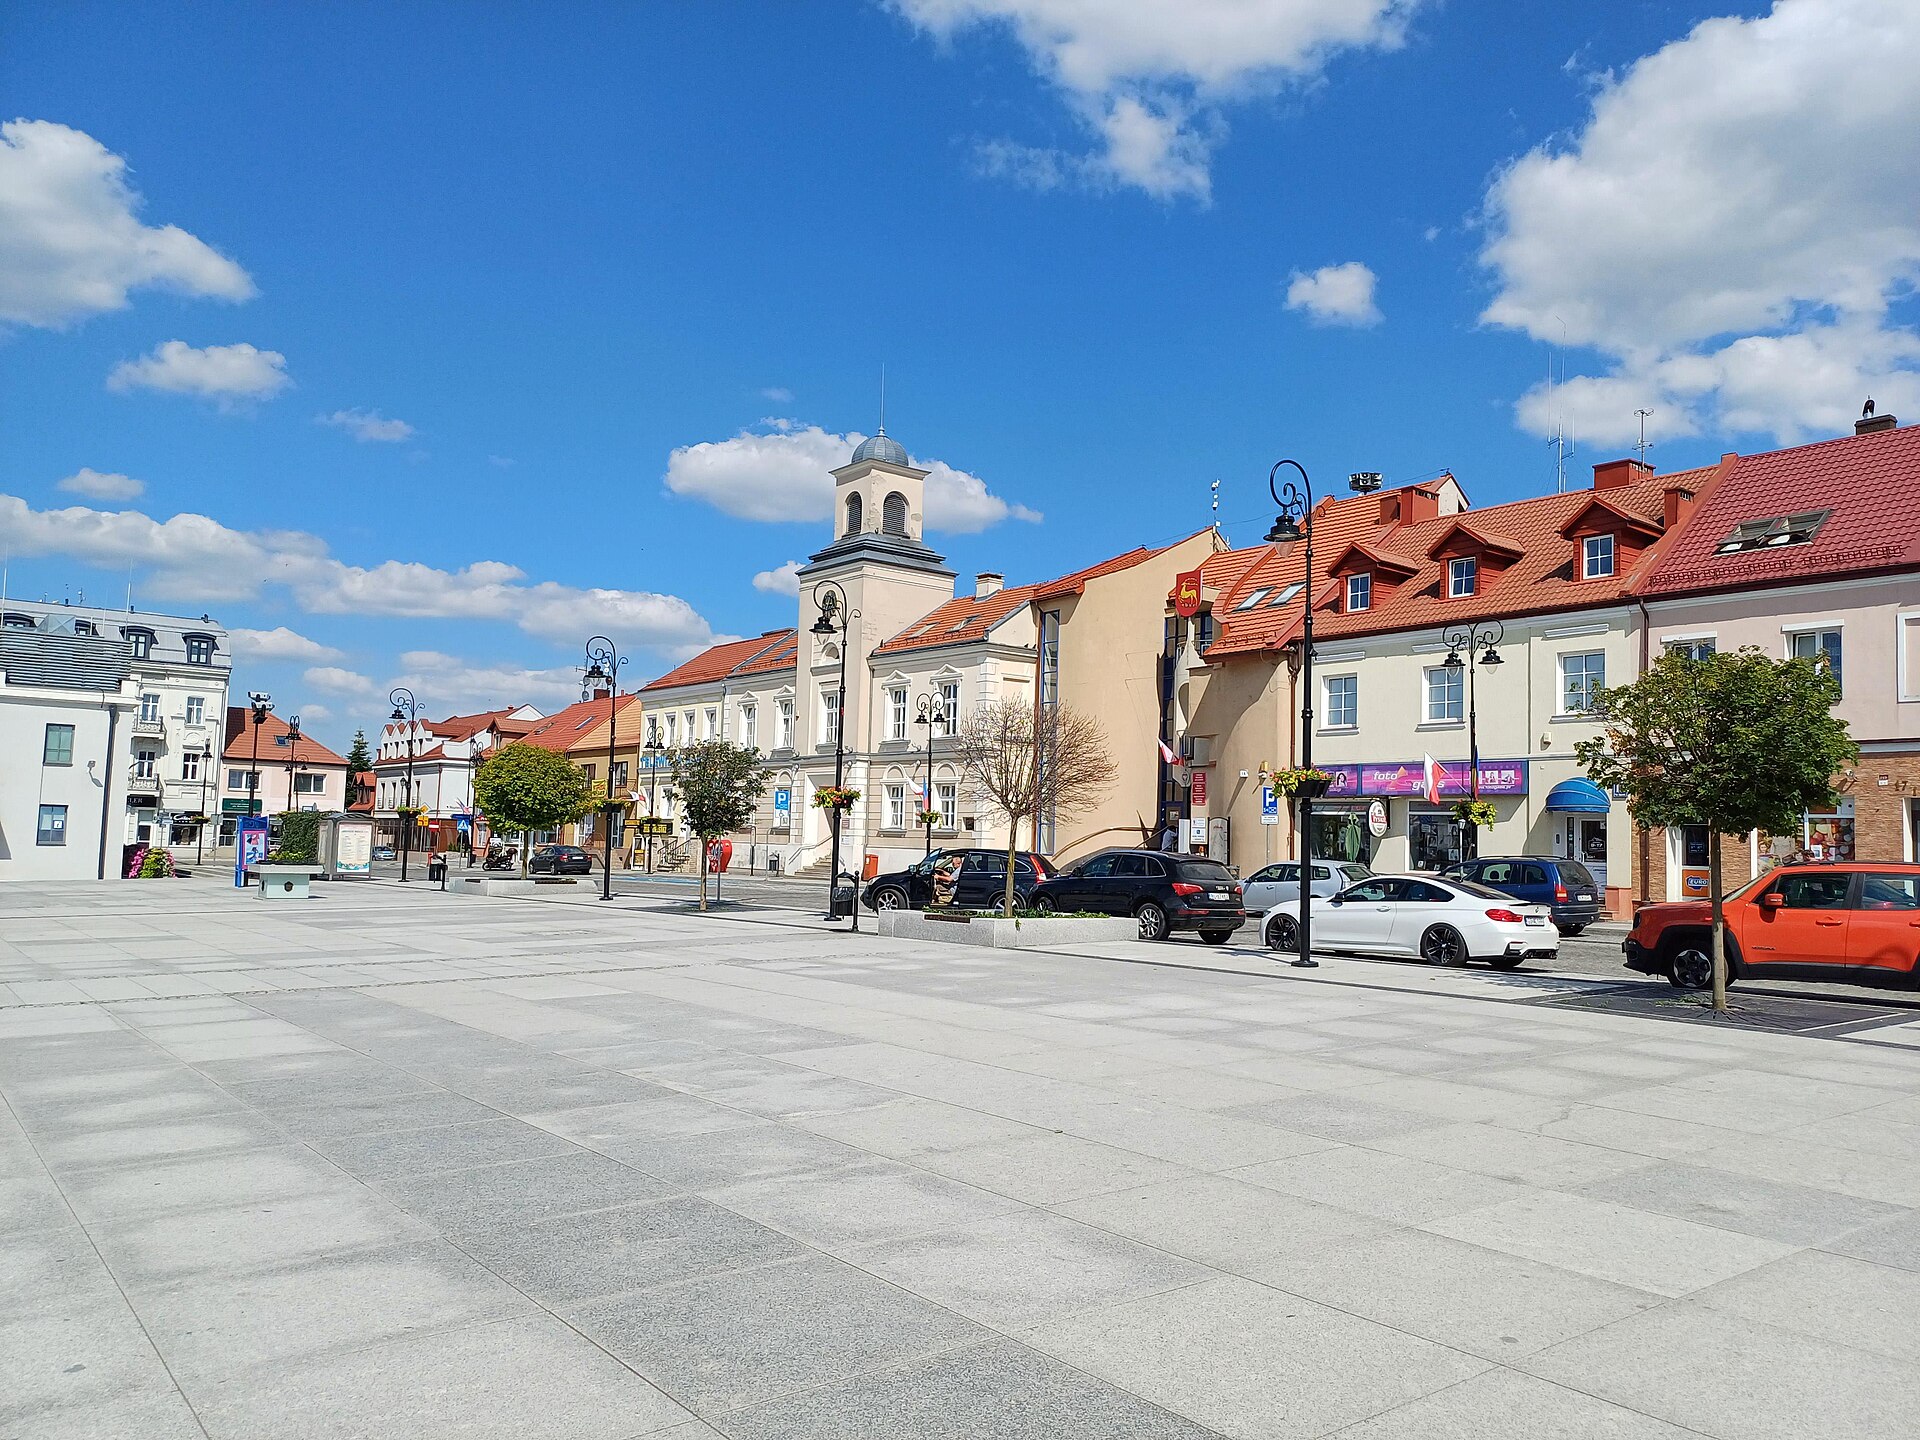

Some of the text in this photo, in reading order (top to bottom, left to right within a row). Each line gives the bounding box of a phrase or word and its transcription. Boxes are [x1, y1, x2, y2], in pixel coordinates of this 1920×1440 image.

[1373, 771, 1398, 780] foto
[777, 792, 787, 805] P
[1265, 789, 1276, 807] P
